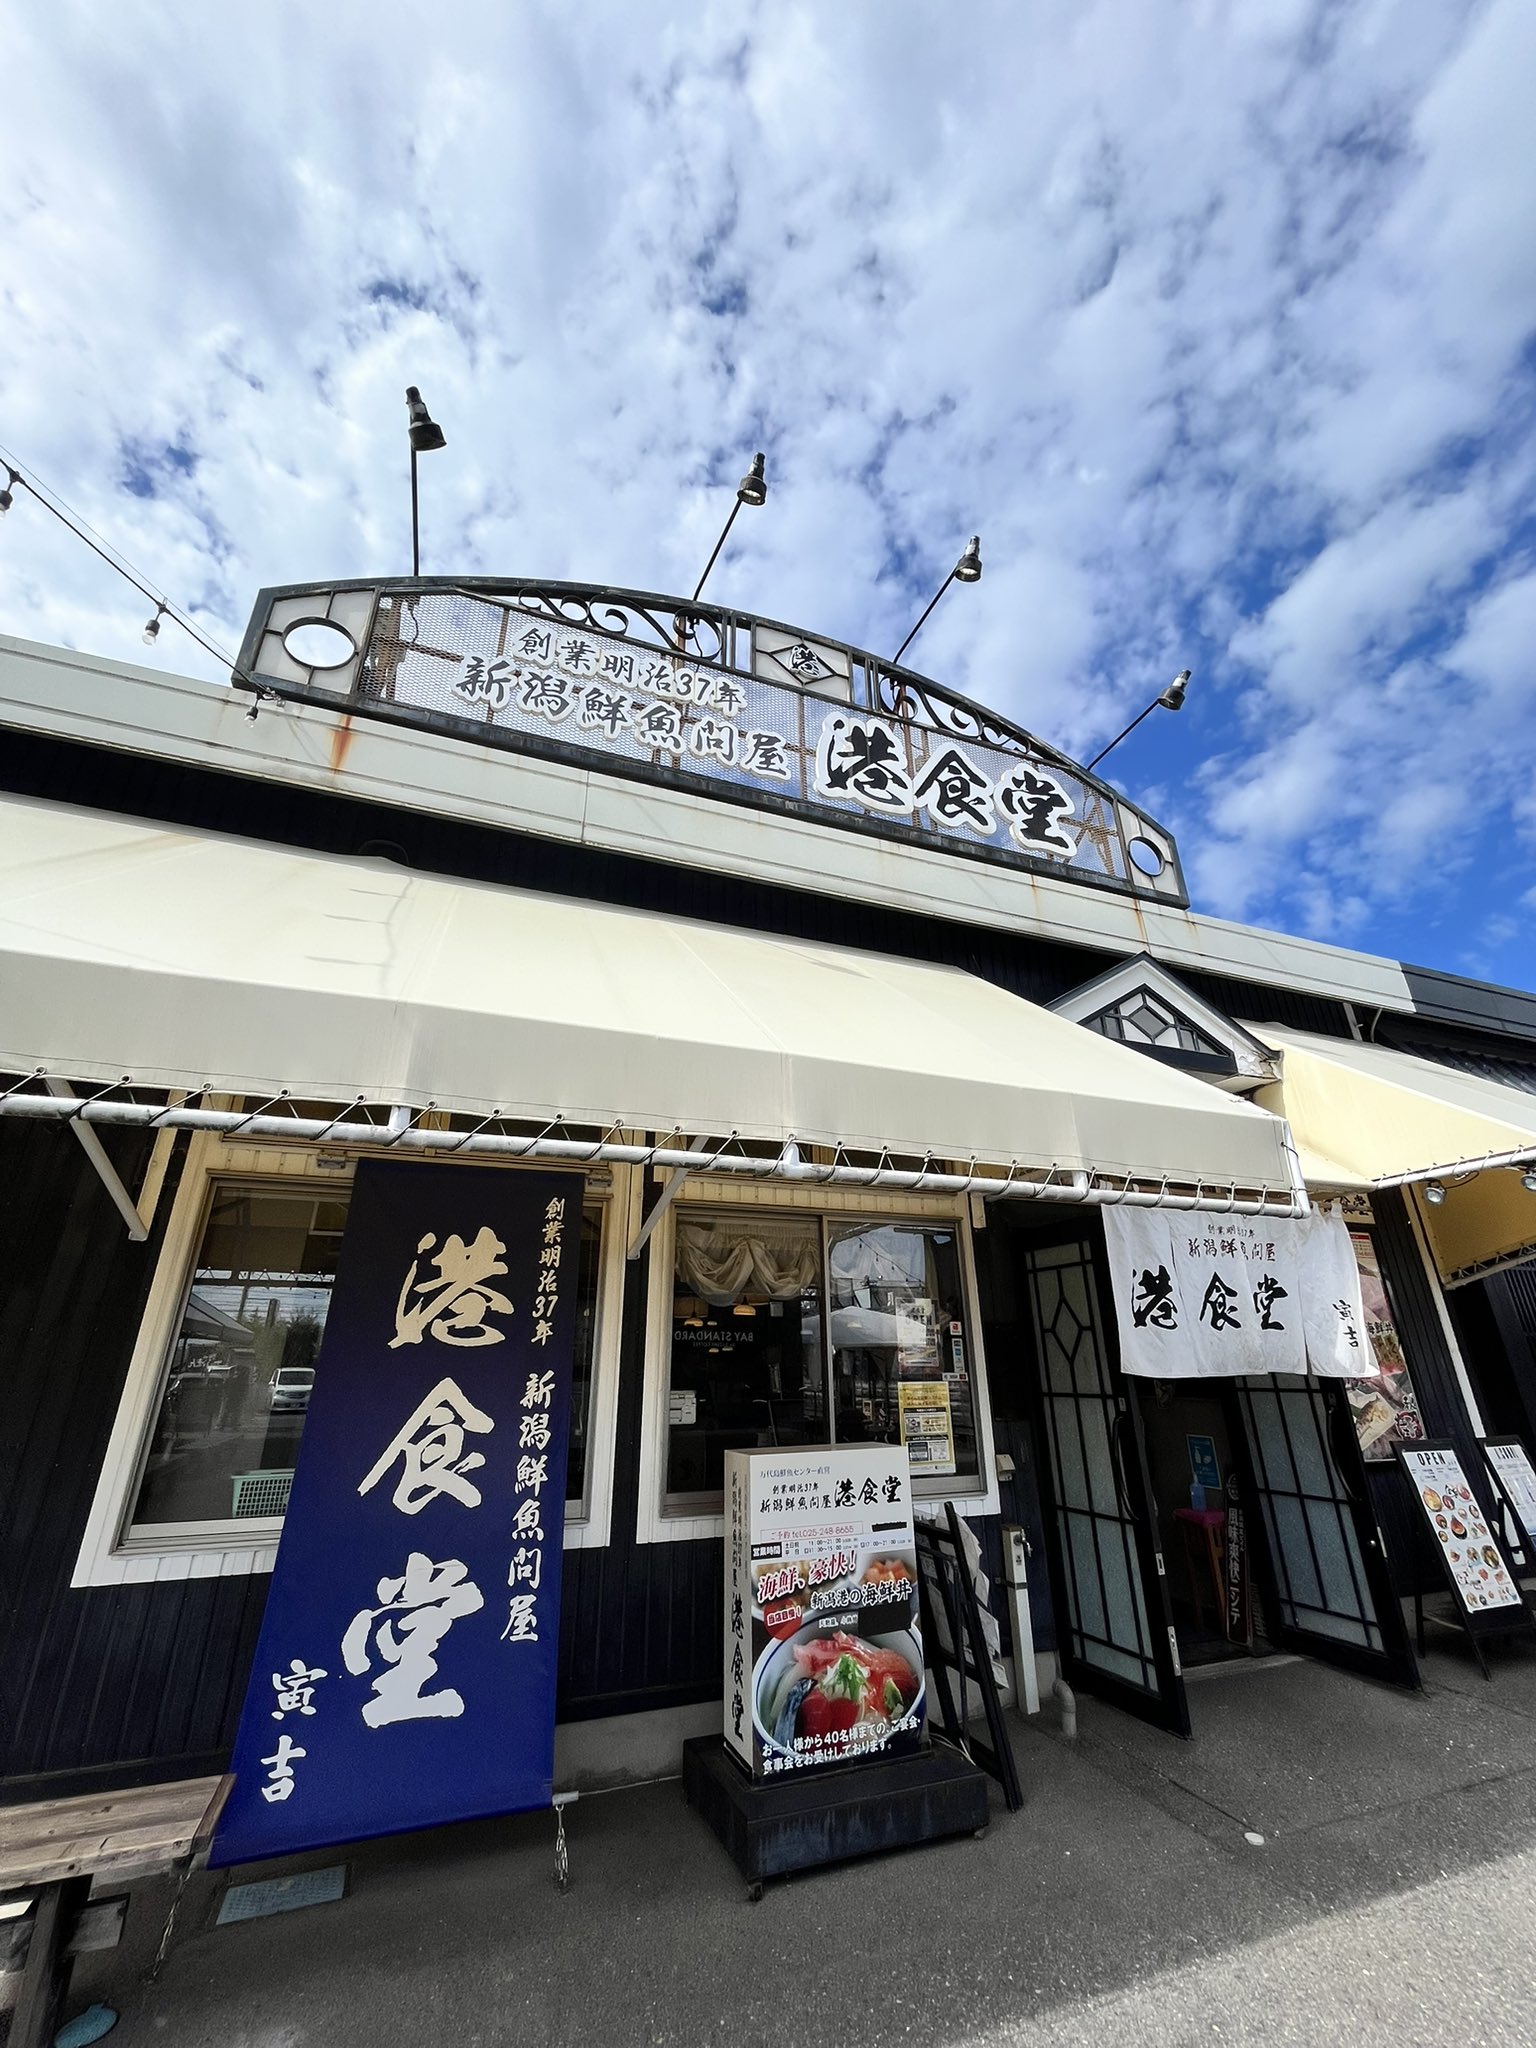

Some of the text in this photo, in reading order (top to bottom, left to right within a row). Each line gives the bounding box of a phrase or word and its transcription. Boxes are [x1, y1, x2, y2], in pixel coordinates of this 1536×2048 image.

[518, 626, 746, 717] 創業明治37年
[790, 645, 820, 677] 港
[455, 655, 788, 777] 新潟鮮魚問屋
[824, 716, 1071, 850] 港食堂
[1131, 1265, 1288, 1331] 港食堂
[1332, 1299, 1359, 1348] 寅吉
[499, 1196, 566, 1643] 創業明治37年 新潟鮮魚問屋
[340, 1226, 514, 1730] 港食堂
[772, 1482, 819, 1495] 創業明治37年
[833, 1475, 902, 1508] 港食堂
[1416, 1452, 1447, 1466] OPEN
[759, 1495, 832, 1513] 新潟鮮魚問屋
[730, 1591, 744, 1742] 港食堂
[260, 1658, 328, 1804] 寅吉
[762, 1739, 892, 1775] 食事会をお受けしております。
